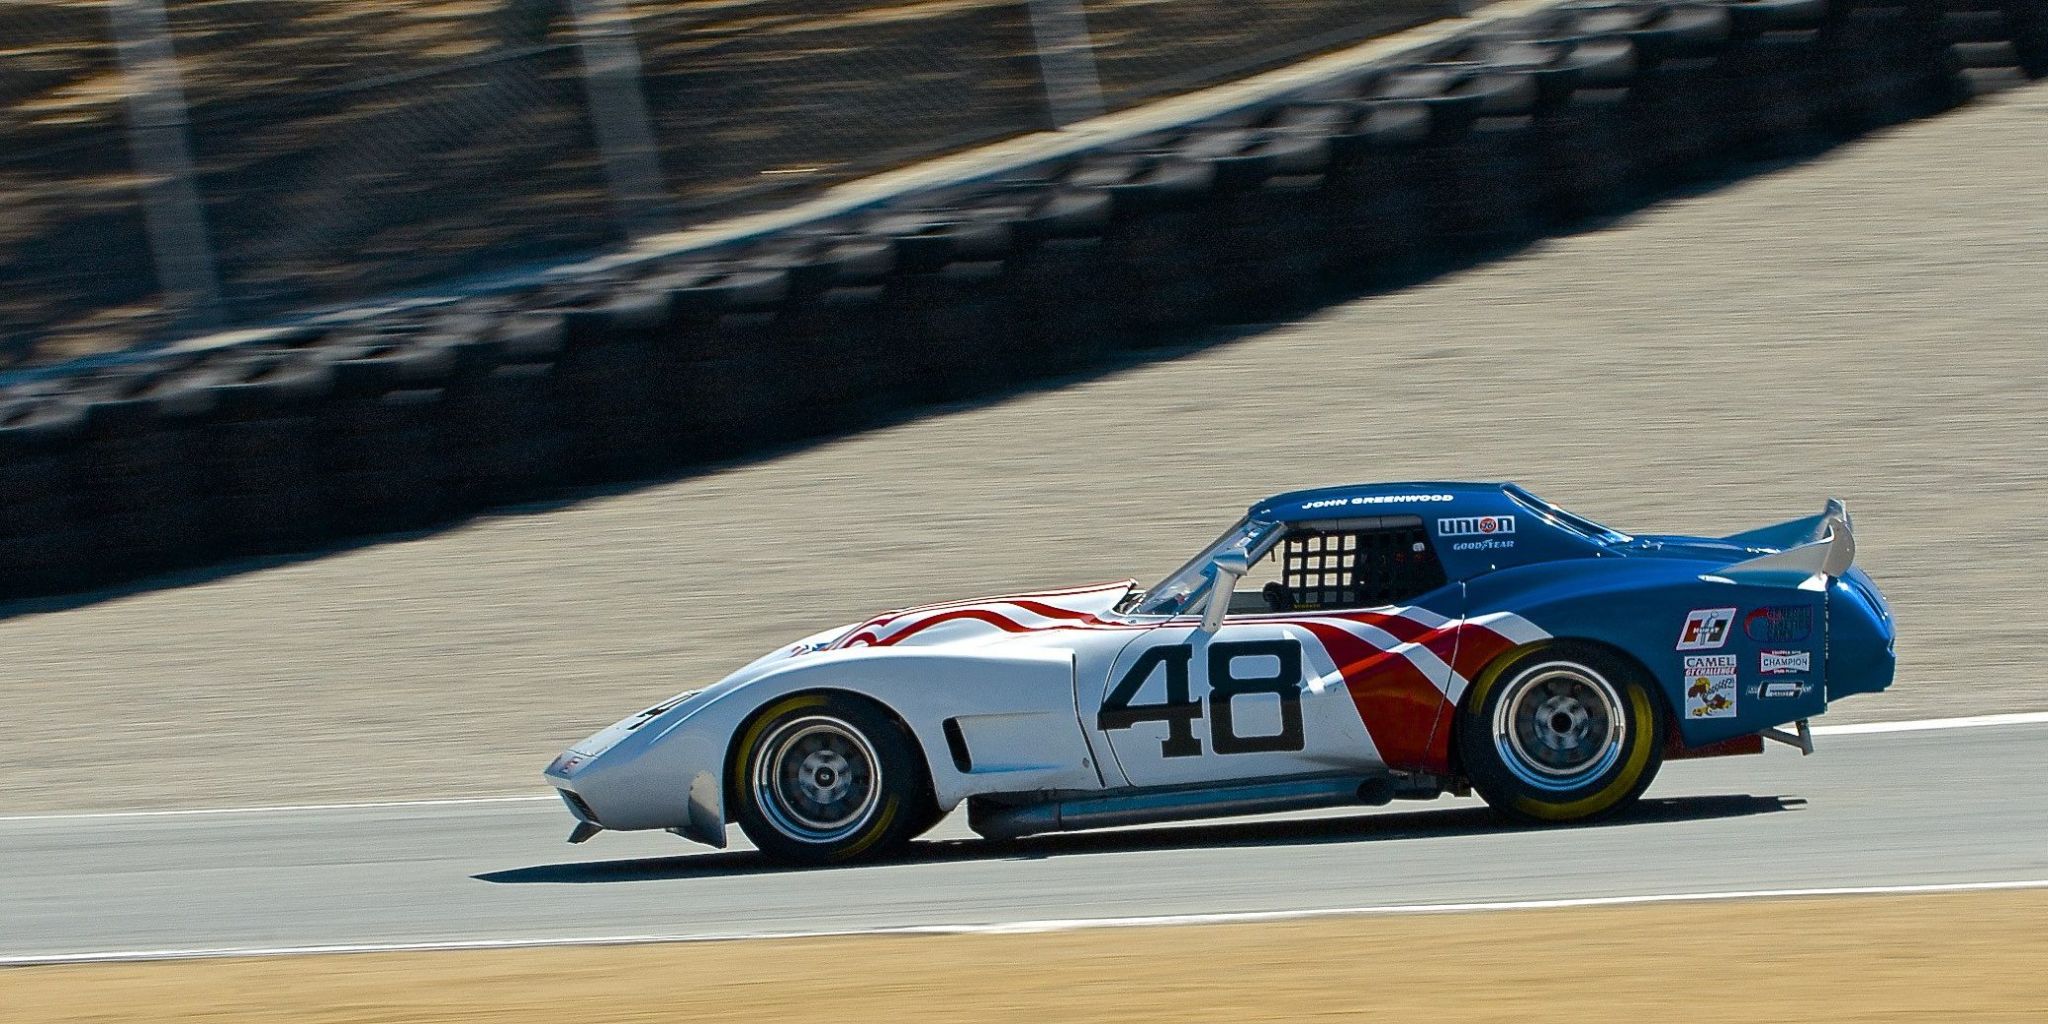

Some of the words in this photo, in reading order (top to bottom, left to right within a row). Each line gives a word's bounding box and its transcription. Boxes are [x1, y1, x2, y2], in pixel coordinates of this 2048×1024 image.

[1302, 498, 1347, 509] JOHN
[1351, 494, 1454, 505] GREENWOOD
[1453, 540, 1515, 551] GOODYEAR
[1686, 657, 1735, 667] CAMEL
[1763, 658, 1808, 667] CHAMPION
[1097, 640, 1305, 758] 48
